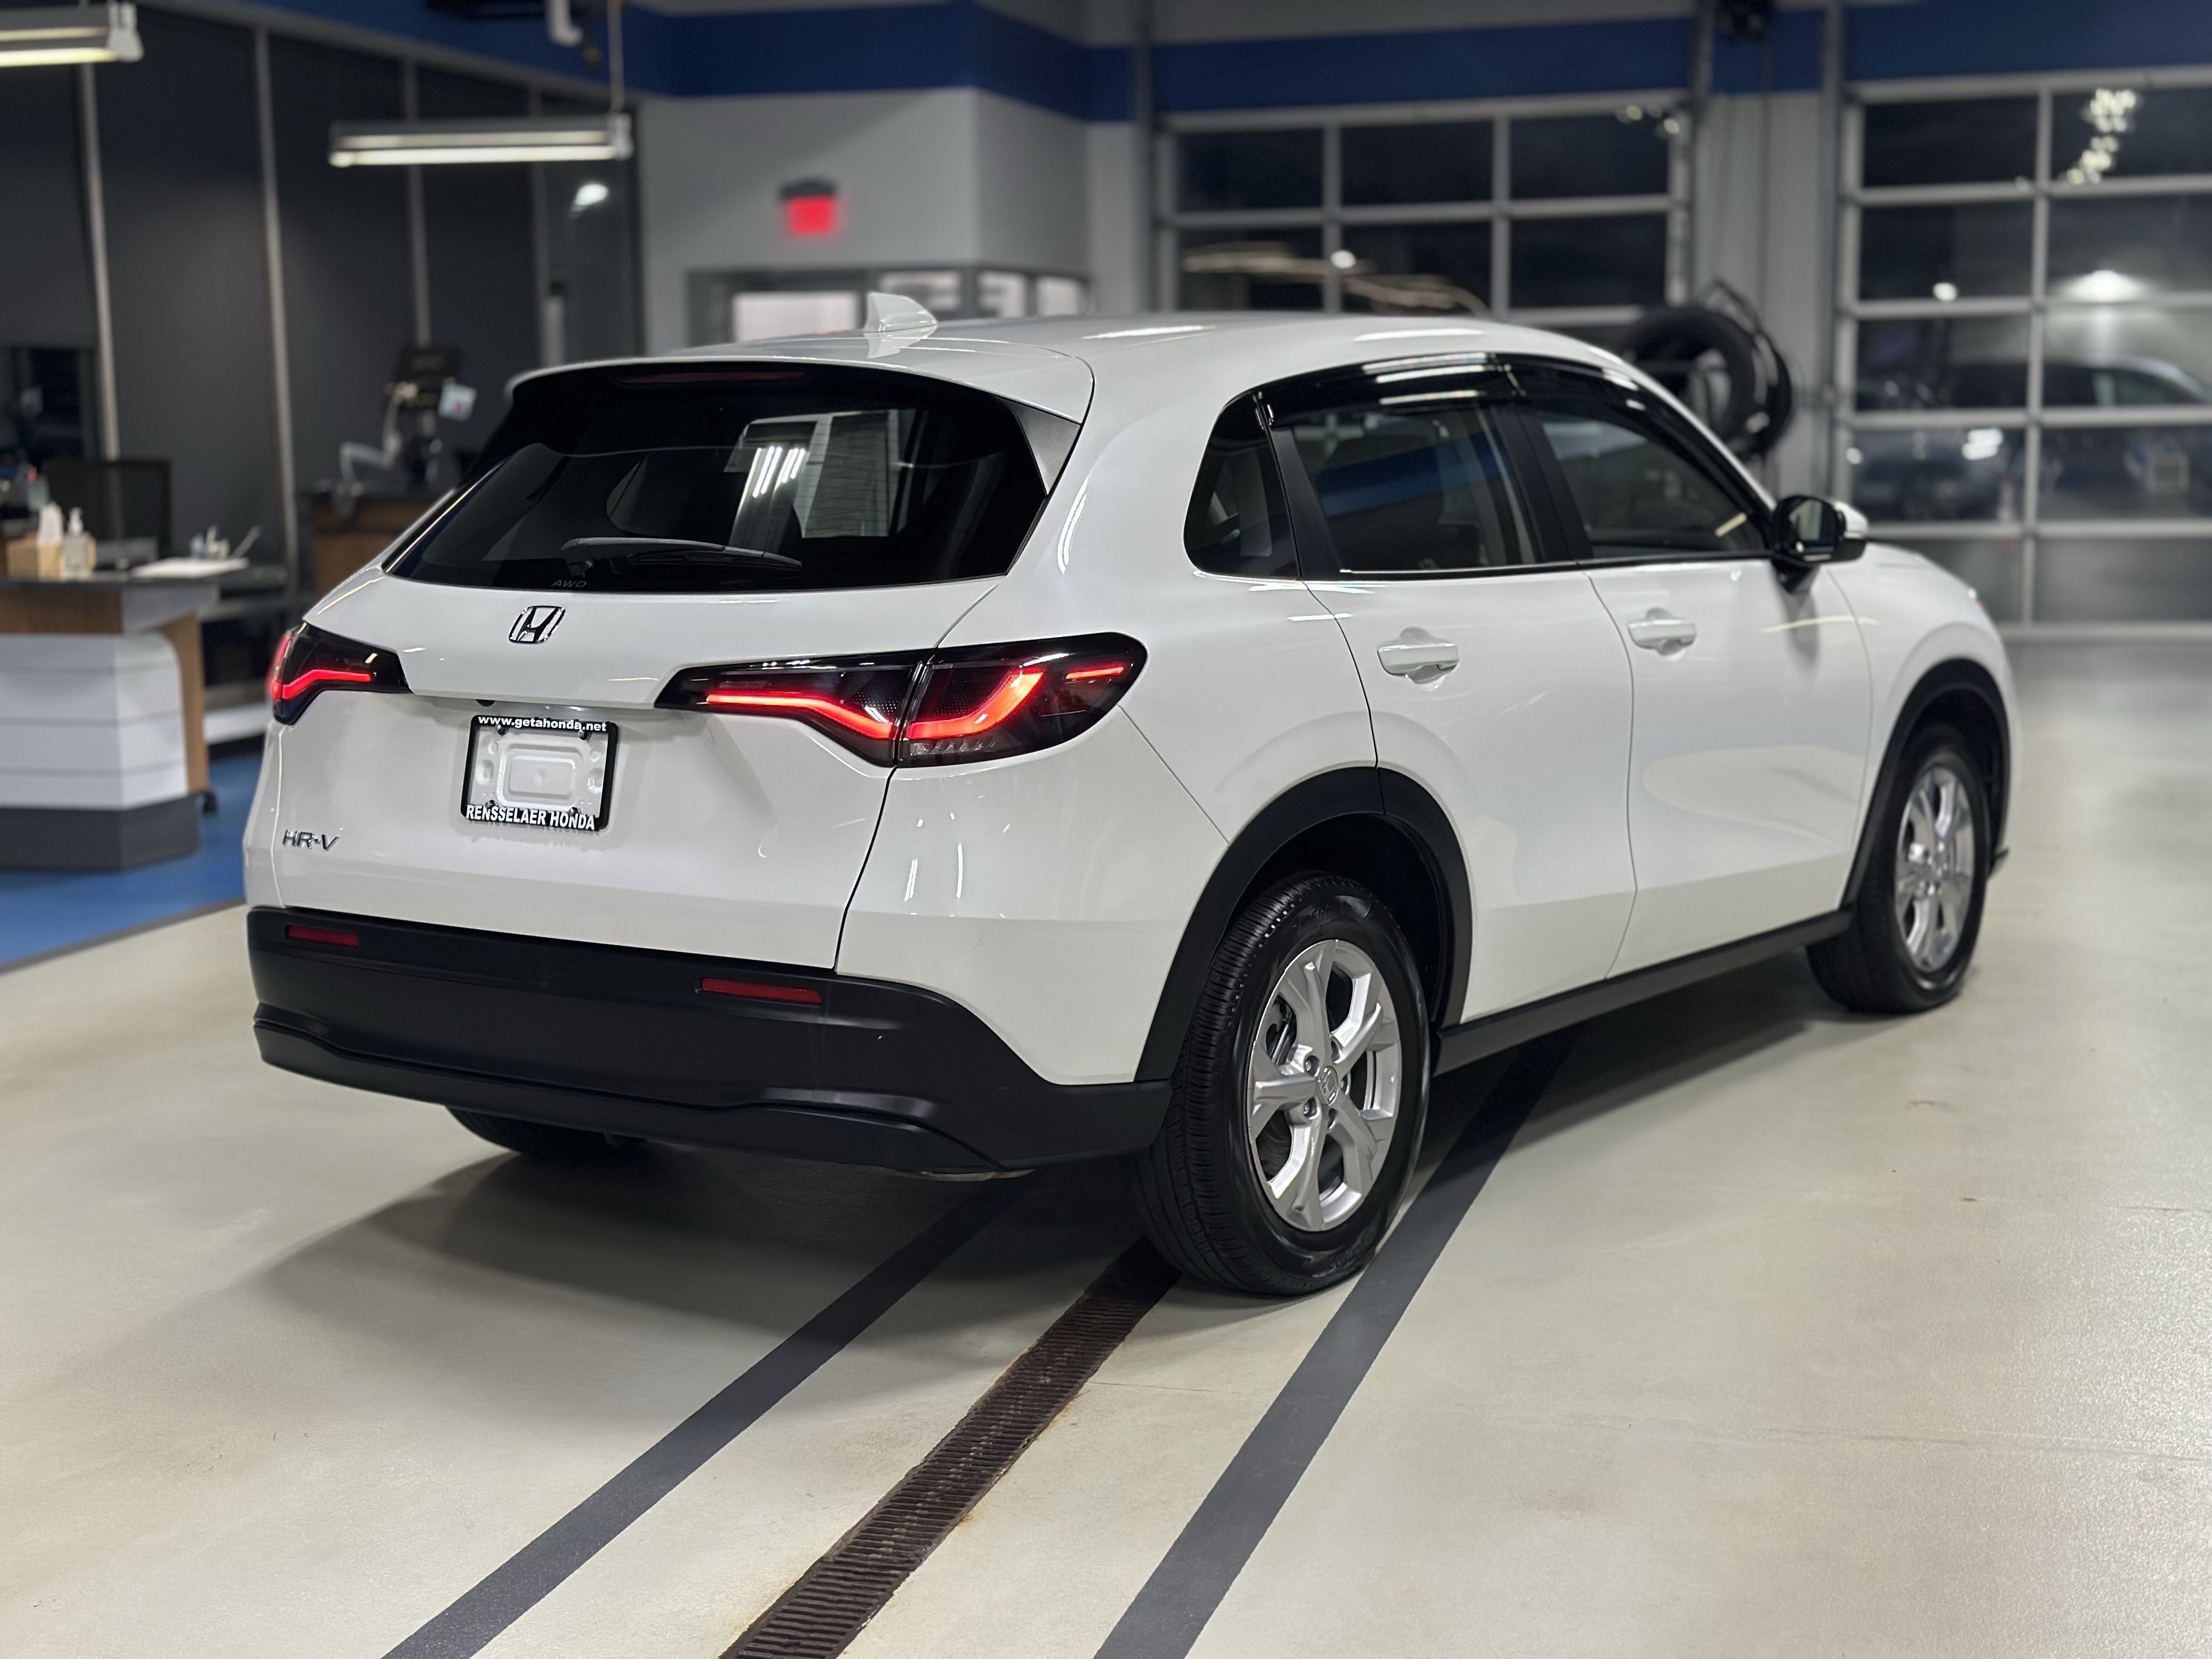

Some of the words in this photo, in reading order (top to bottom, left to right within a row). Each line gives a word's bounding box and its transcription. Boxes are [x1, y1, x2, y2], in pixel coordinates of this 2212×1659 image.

[478, 716, 607, 732] www.getahonda.net
[466, 805, 546, 825] RENSSELAER
[550, 811, 595, 830] HONDA
[283, 830, 340, 851] HR-V
